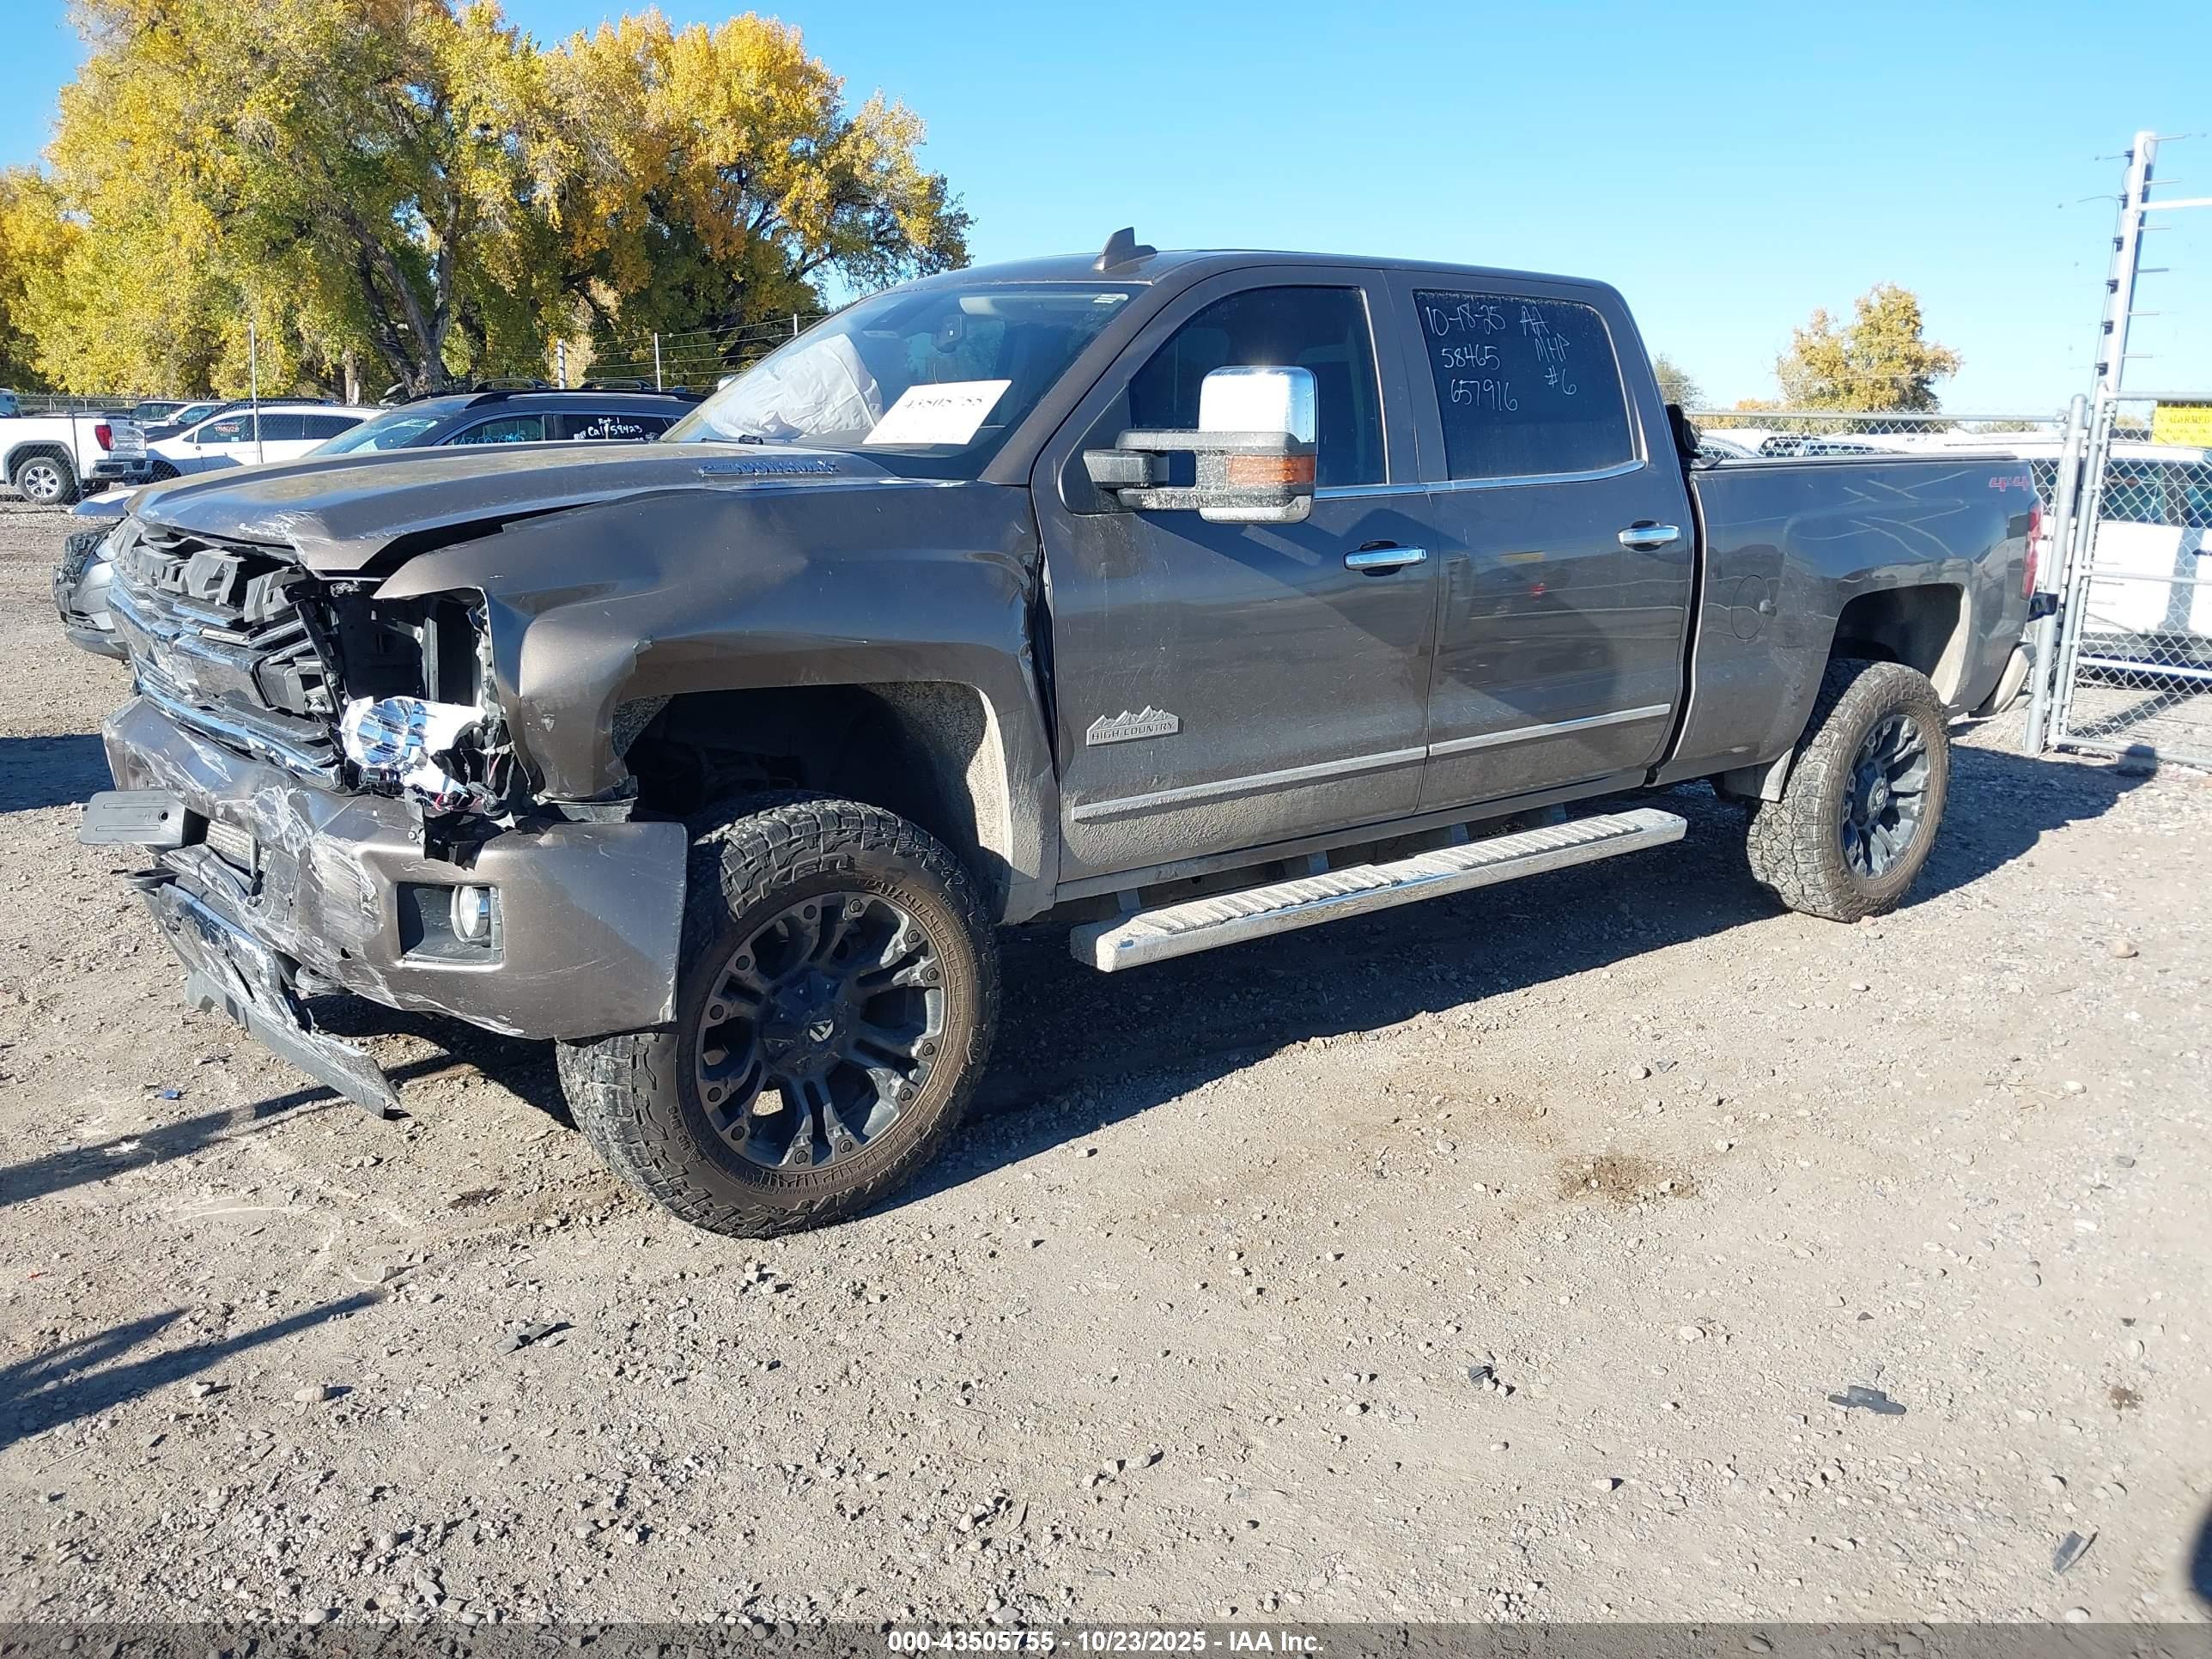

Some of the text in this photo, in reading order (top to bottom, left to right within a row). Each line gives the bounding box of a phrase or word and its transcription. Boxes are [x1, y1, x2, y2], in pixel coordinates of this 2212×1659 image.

[1425, 303, 1505, 336] 10-18-25
[1442, 343, 1500, 370] 58465
[1451, 379, 1518, 411] 657916
[1091, 722, 1176, 740] HIGH COUNTRY
